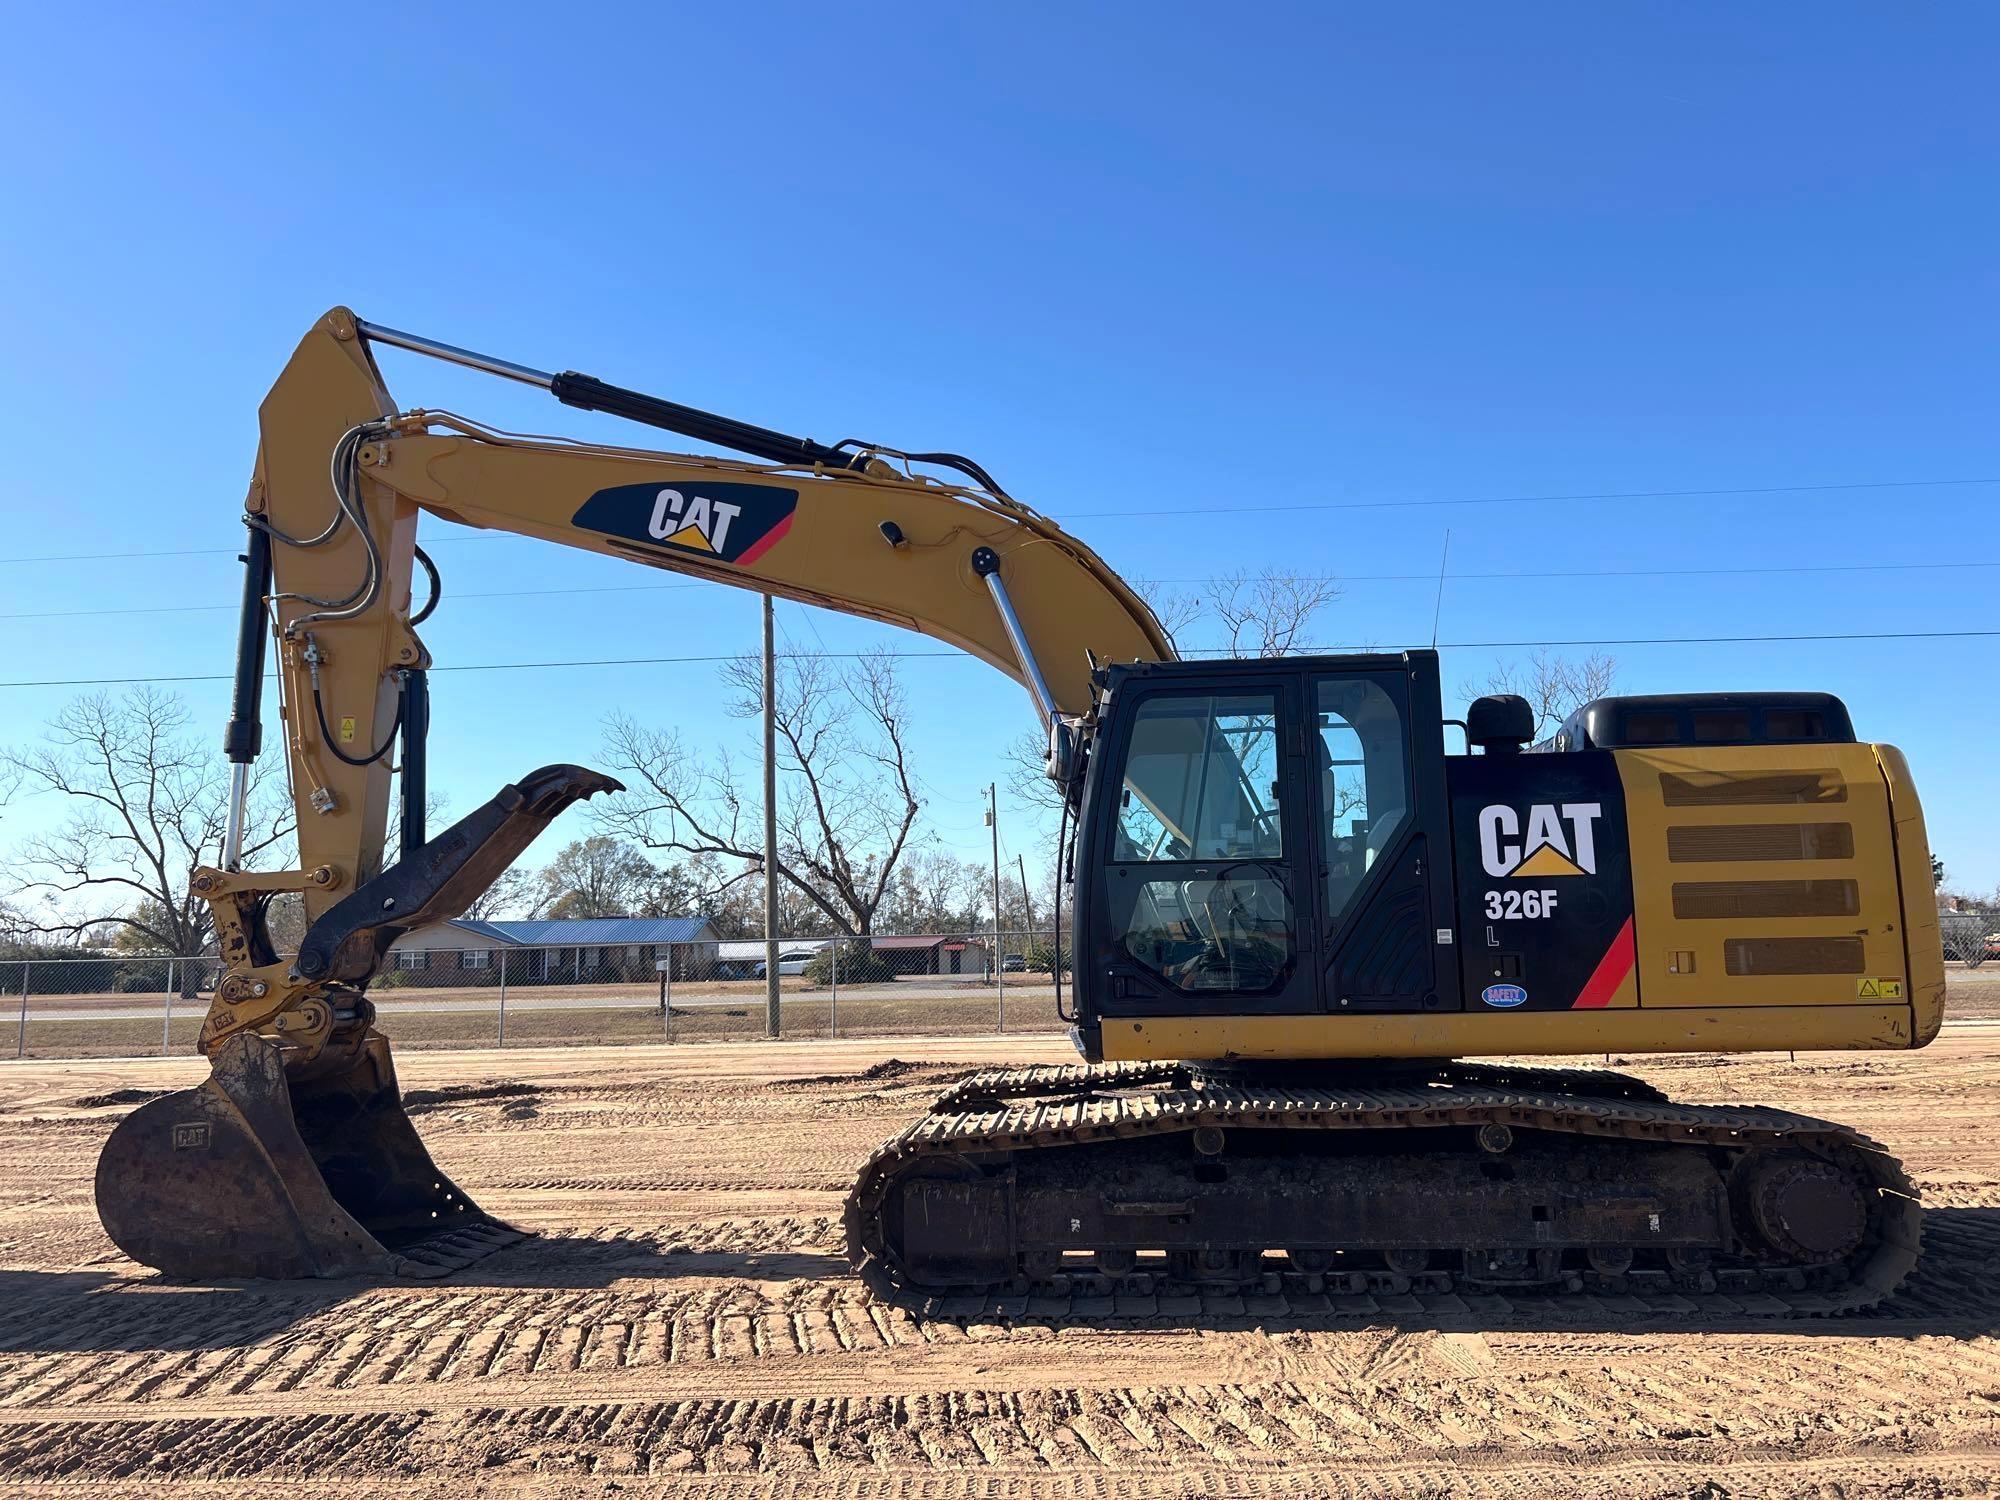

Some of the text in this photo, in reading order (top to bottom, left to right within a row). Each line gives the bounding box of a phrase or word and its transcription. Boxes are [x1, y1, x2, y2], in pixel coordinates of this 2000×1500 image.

[648, 488, 742, 554] CAT
[1478, 803, 1601, 877] CAT
[1484, 890, 1558, 920] 326F
[1486, 926, 1500, 947] L
[1487, 988, 1520, 999] SAFETY
[215, 1012, 232, 1029] CAT
[177, 1128, 206, 1147] CAT
